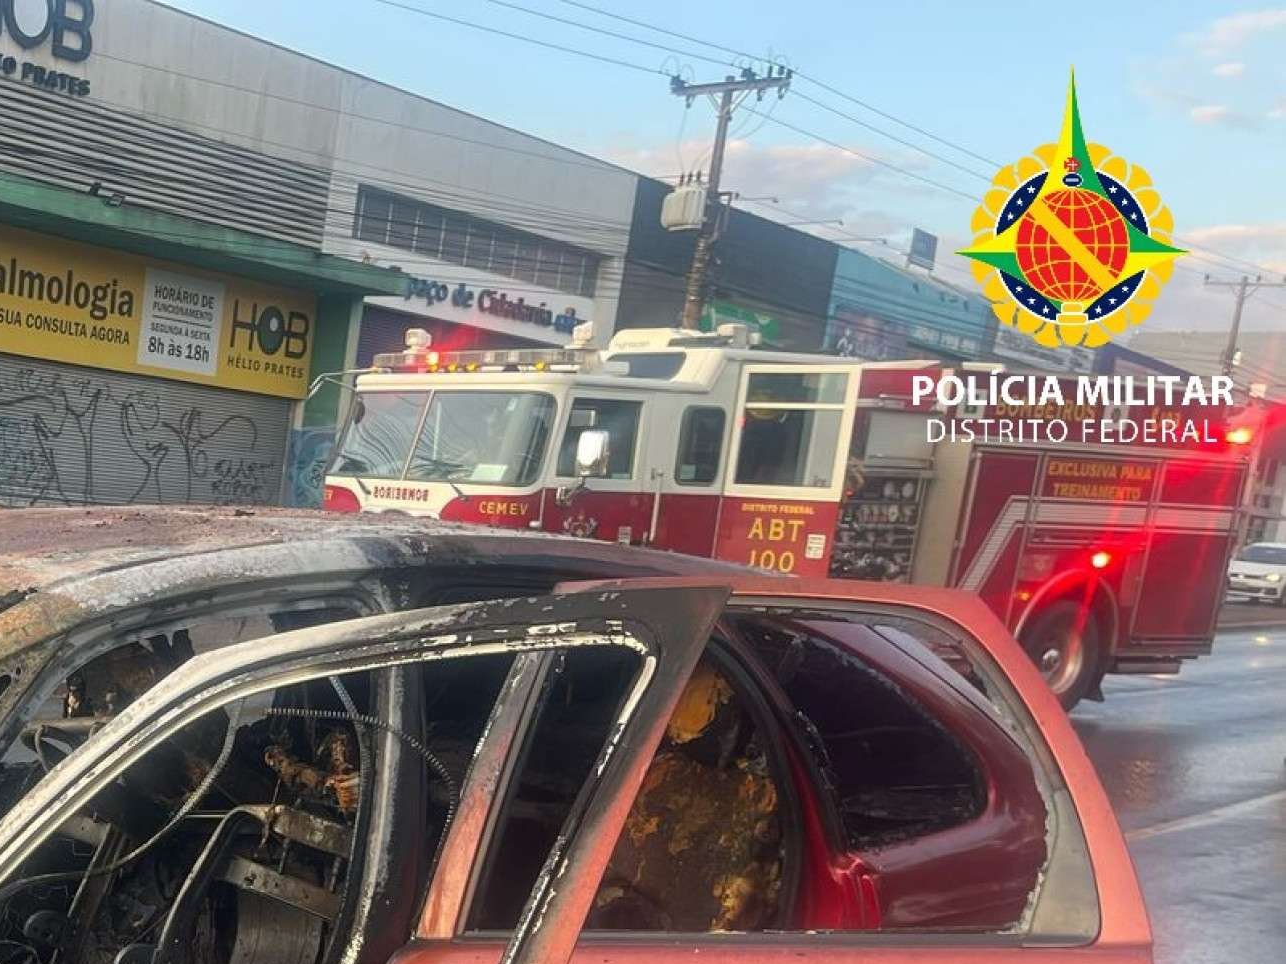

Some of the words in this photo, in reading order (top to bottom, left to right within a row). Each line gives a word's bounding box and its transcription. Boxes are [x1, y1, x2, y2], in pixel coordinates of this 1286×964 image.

[21, 62, 91, 96] PRATES
[154, 285, 199, 306] HORÁRIO
[202, 295, 215, 310] DE
[26, 313, 87, 339] CONSULTA
[90, 326, 130, 345] AGORA
[229, 299, 310, 360] HOB
[147, 336, 164, 354] 8h
[167, 338, 182, 358] às
[185, 343, 210, 363] 18h
[227, 355, 262, 372] HÉLIO
[264, 362, 305, 379] PRATES
[1049, 461, 1117, 479] EXCLUSIVA
[1120, 465, 1152, 480] PARA
[1053, 483, 1141, 501] TREINAMENTO
[479, 500, 529, 516] CEMEV
[747, 517, 805, 542] ABT
[749, 549, 795, 574] 100
